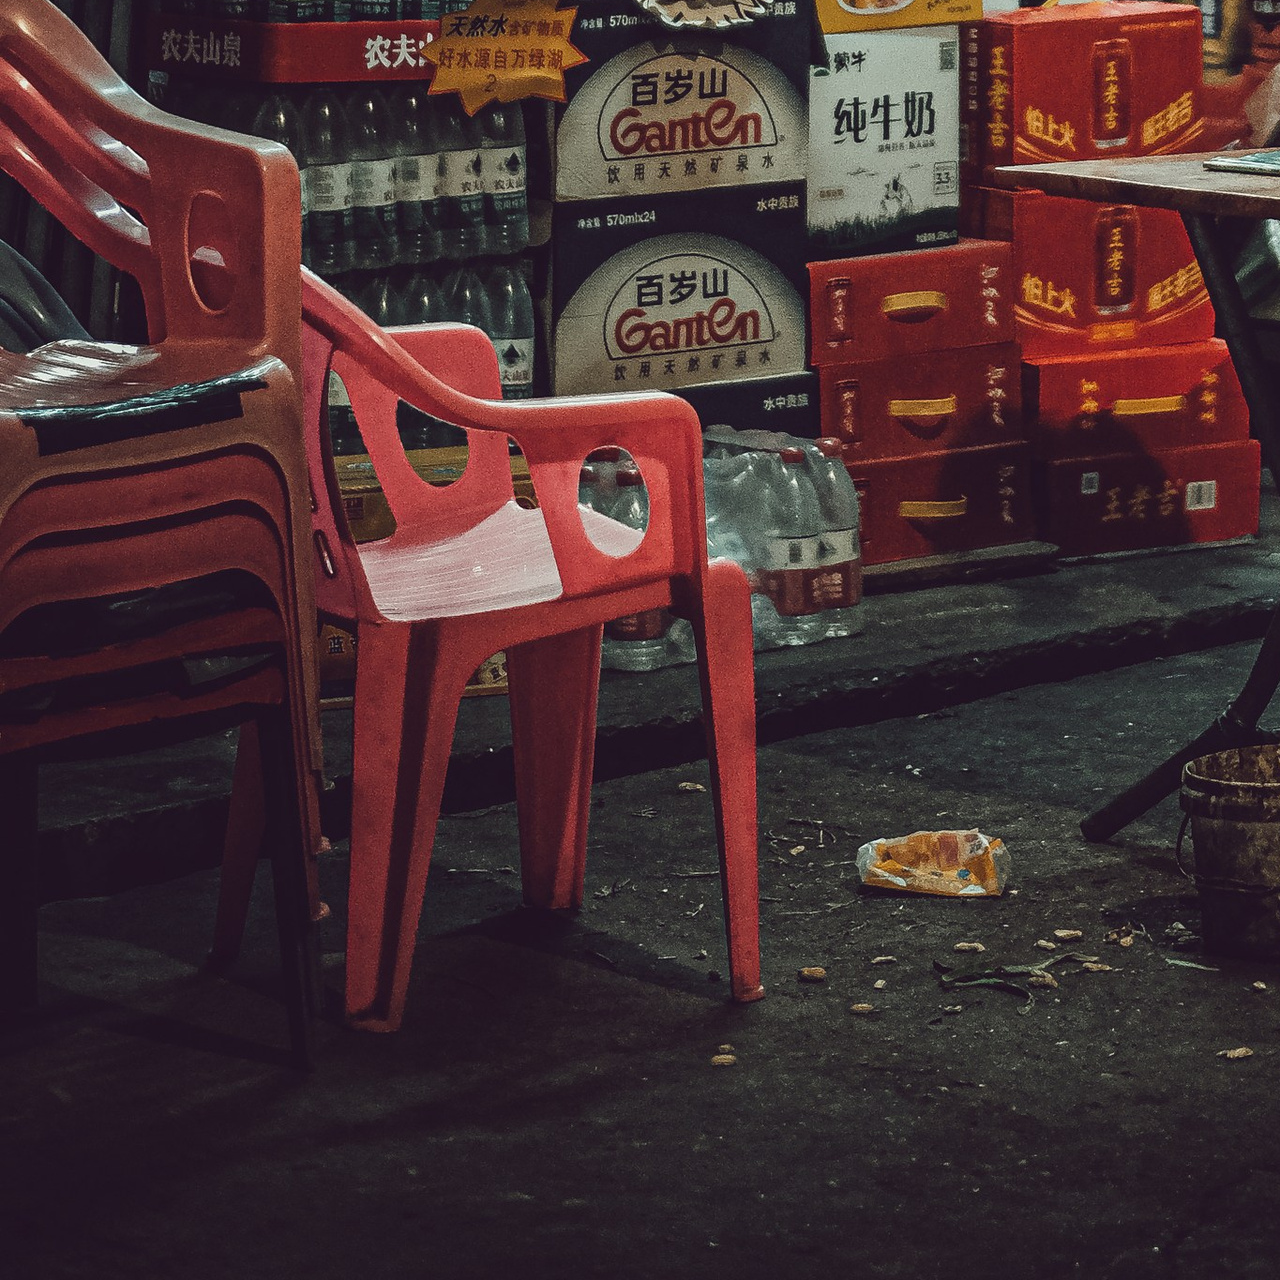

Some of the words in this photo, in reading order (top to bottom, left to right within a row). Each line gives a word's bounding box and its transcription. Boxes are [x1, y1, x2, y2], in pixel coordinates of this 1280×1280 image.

[161, 29, 242, 68] 农夫山泉
[438, 47, 564, 70] 好水源自万绿湖
[630, 66, 729, 108] 百岁山
[988, 45, 1009, 149] 王老吉
[1104, 59, 1118, 131] 王老吉
[833, 90, 936, 145] 纯牛奶
[606, 152, 775, 184] 饮用天然矿泉水
[756, 195, 800, 213] 水中贵族
[1107, 226, 1123, 297] 王老吉
[635, 267, 729, 307] 百岁山
[613, 348, 771, 382] 饮用天然矿泉水
[763, 393, 809, 412] 水中贵族
[1101, 478, 1182, 523] 王老吉
